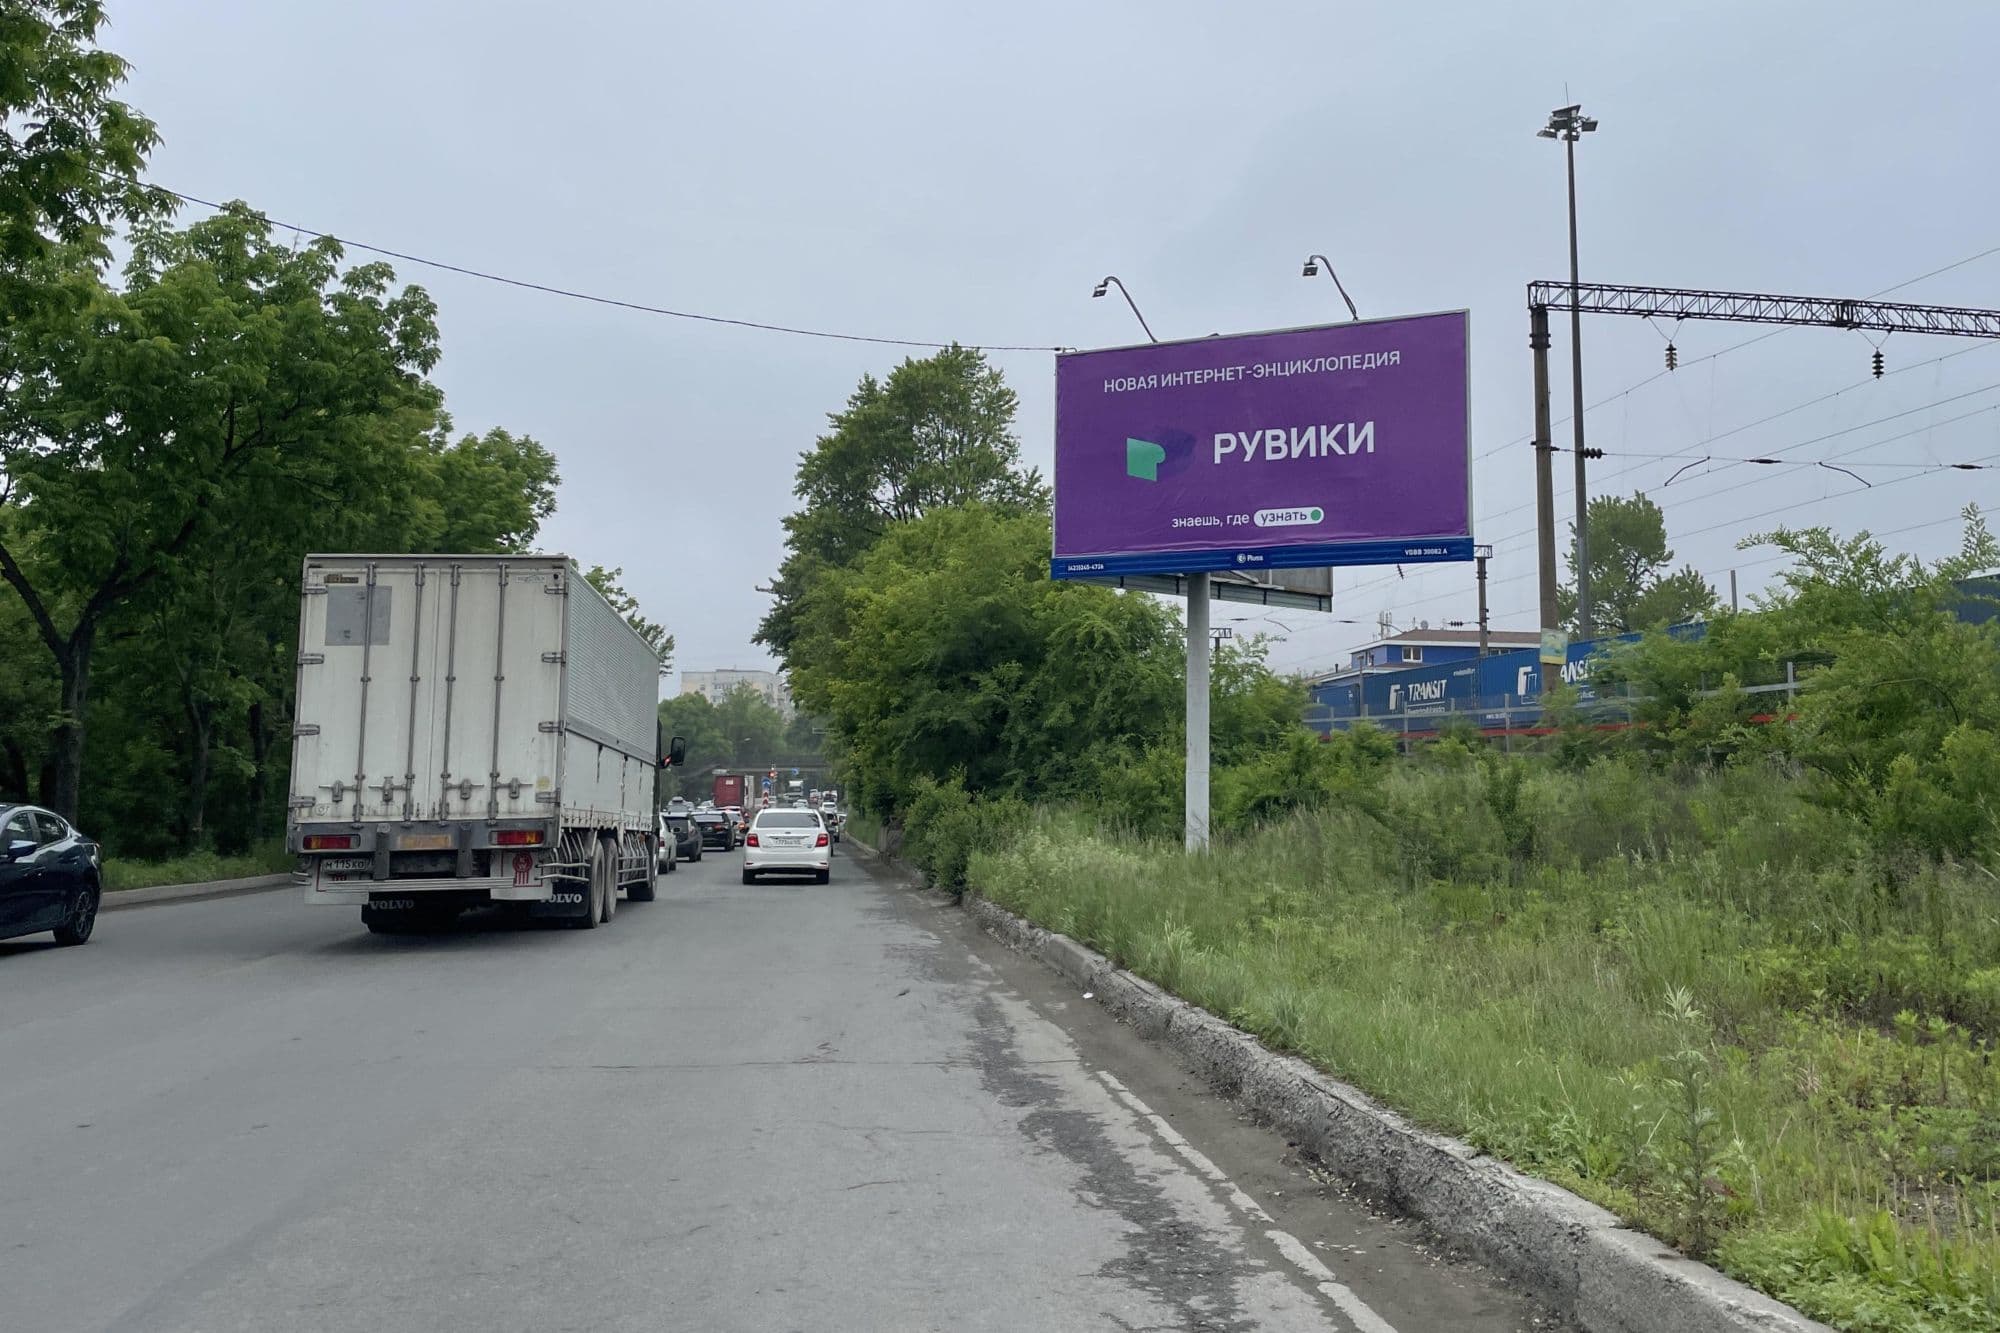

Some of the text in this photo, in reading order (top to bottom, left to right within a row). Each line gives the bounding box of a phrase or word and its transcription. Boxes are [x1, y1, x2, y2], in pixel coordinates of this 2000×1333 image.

[1104, 350, 1400, 393] НОВАЯ ИНТЕРНЕТ-ЭНЦИКЛОПЕДИЯ
[1214, 421, 1374, 464] РУВИКИ
[1171, 511, 1308, 528] знаешь, где узнать
[1408, 679, 1448, 702] TRANSIT
[369, 899, 415, 911] VOLVO
[541, 893, 583, 904] OLVO
